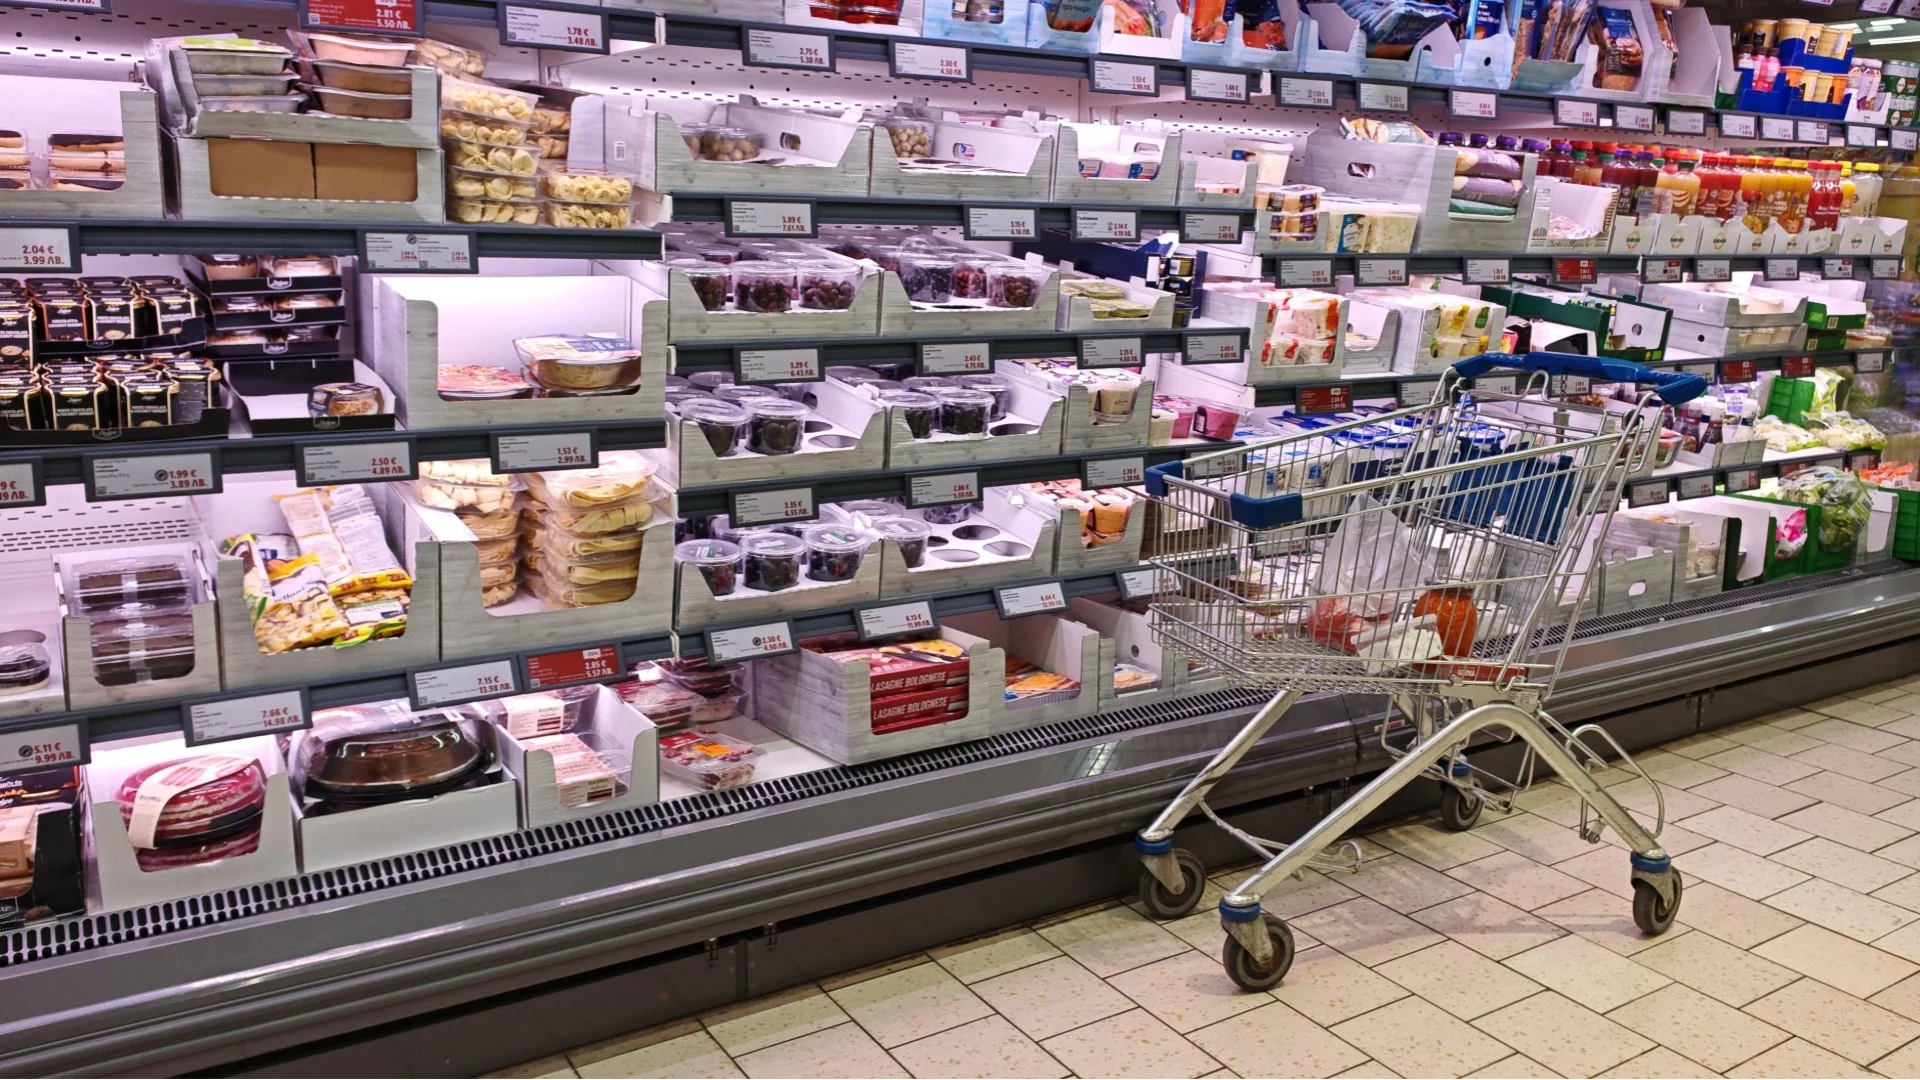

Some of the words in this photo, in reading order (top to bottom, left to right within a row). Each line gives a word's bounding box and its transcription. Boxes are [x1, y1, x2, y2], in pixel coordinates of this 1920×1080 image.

[377, 9, 393, 18] 2.81
[395, 11, 401, 19] €
[377, 19, 394, 28] 5.50
[567, 27, 582, 36] 1.78
[584, 29, 589, 37] €
[567, 36, 583, 46] 3.48
[799, 48, 813, 56] 2.75
[22, 245, 45, 255] 2.04
[48, 245, 54, 254] €
[23, 255, 45, 265] 3.99
[789, 361, 804, 369] 3.29
[965, 362, 977, 370] 4.75
[790, 369, 804, 377] 6.43
[557, 448, 574, 456] 1.53
[574, 447, 579, 455] €
[371, 458, 390, 466] 2.50
[391, 457, 397, 465] €
[557, 455, 575, 464] 2.99
[169, 469, 190, 479] 1.99
[190, 469, 197, 478] €
[372, 466, 390, 475] 4.89
[10, 481, 17, 490] €
[170, 479, 191, 489] 3.89
[784, 501, 797, 510] 3.35
[784, 509, 798, 517] 6.55
[905, 614, 917, 622] 6.13
[907, 620, 922, 629] 11.99
[761, 636, 776, 645] 2.30
[777, 635, 782, 643] €
[763, 642, 778, 652] 4.50
[584, 661, 600, 671] 2.85
[601, 660, 607, 668] €
[586, 669, 602, 678] 5.57
[477, 677, 494, 686] 7.15
[495, 675, 500, 684] €
[871, 678, 904, 693] LASAGNE
[905, 671, 947, 688] BOLOGNESE
[478, 684, 499, 694] 13.98
[873, 703, 905, 720] LASAGNE
[906, 695, 949, 714] BOLOGNESE
[262, 709, 282, 719] 7.66
[283, 707, 289, 716] €
[264, 716, 286, 728] 14.98
[34, 745, 52, 754] 5.11
[55, 743, 62, 751] €
[35, 753, 57, 764] 9.99
